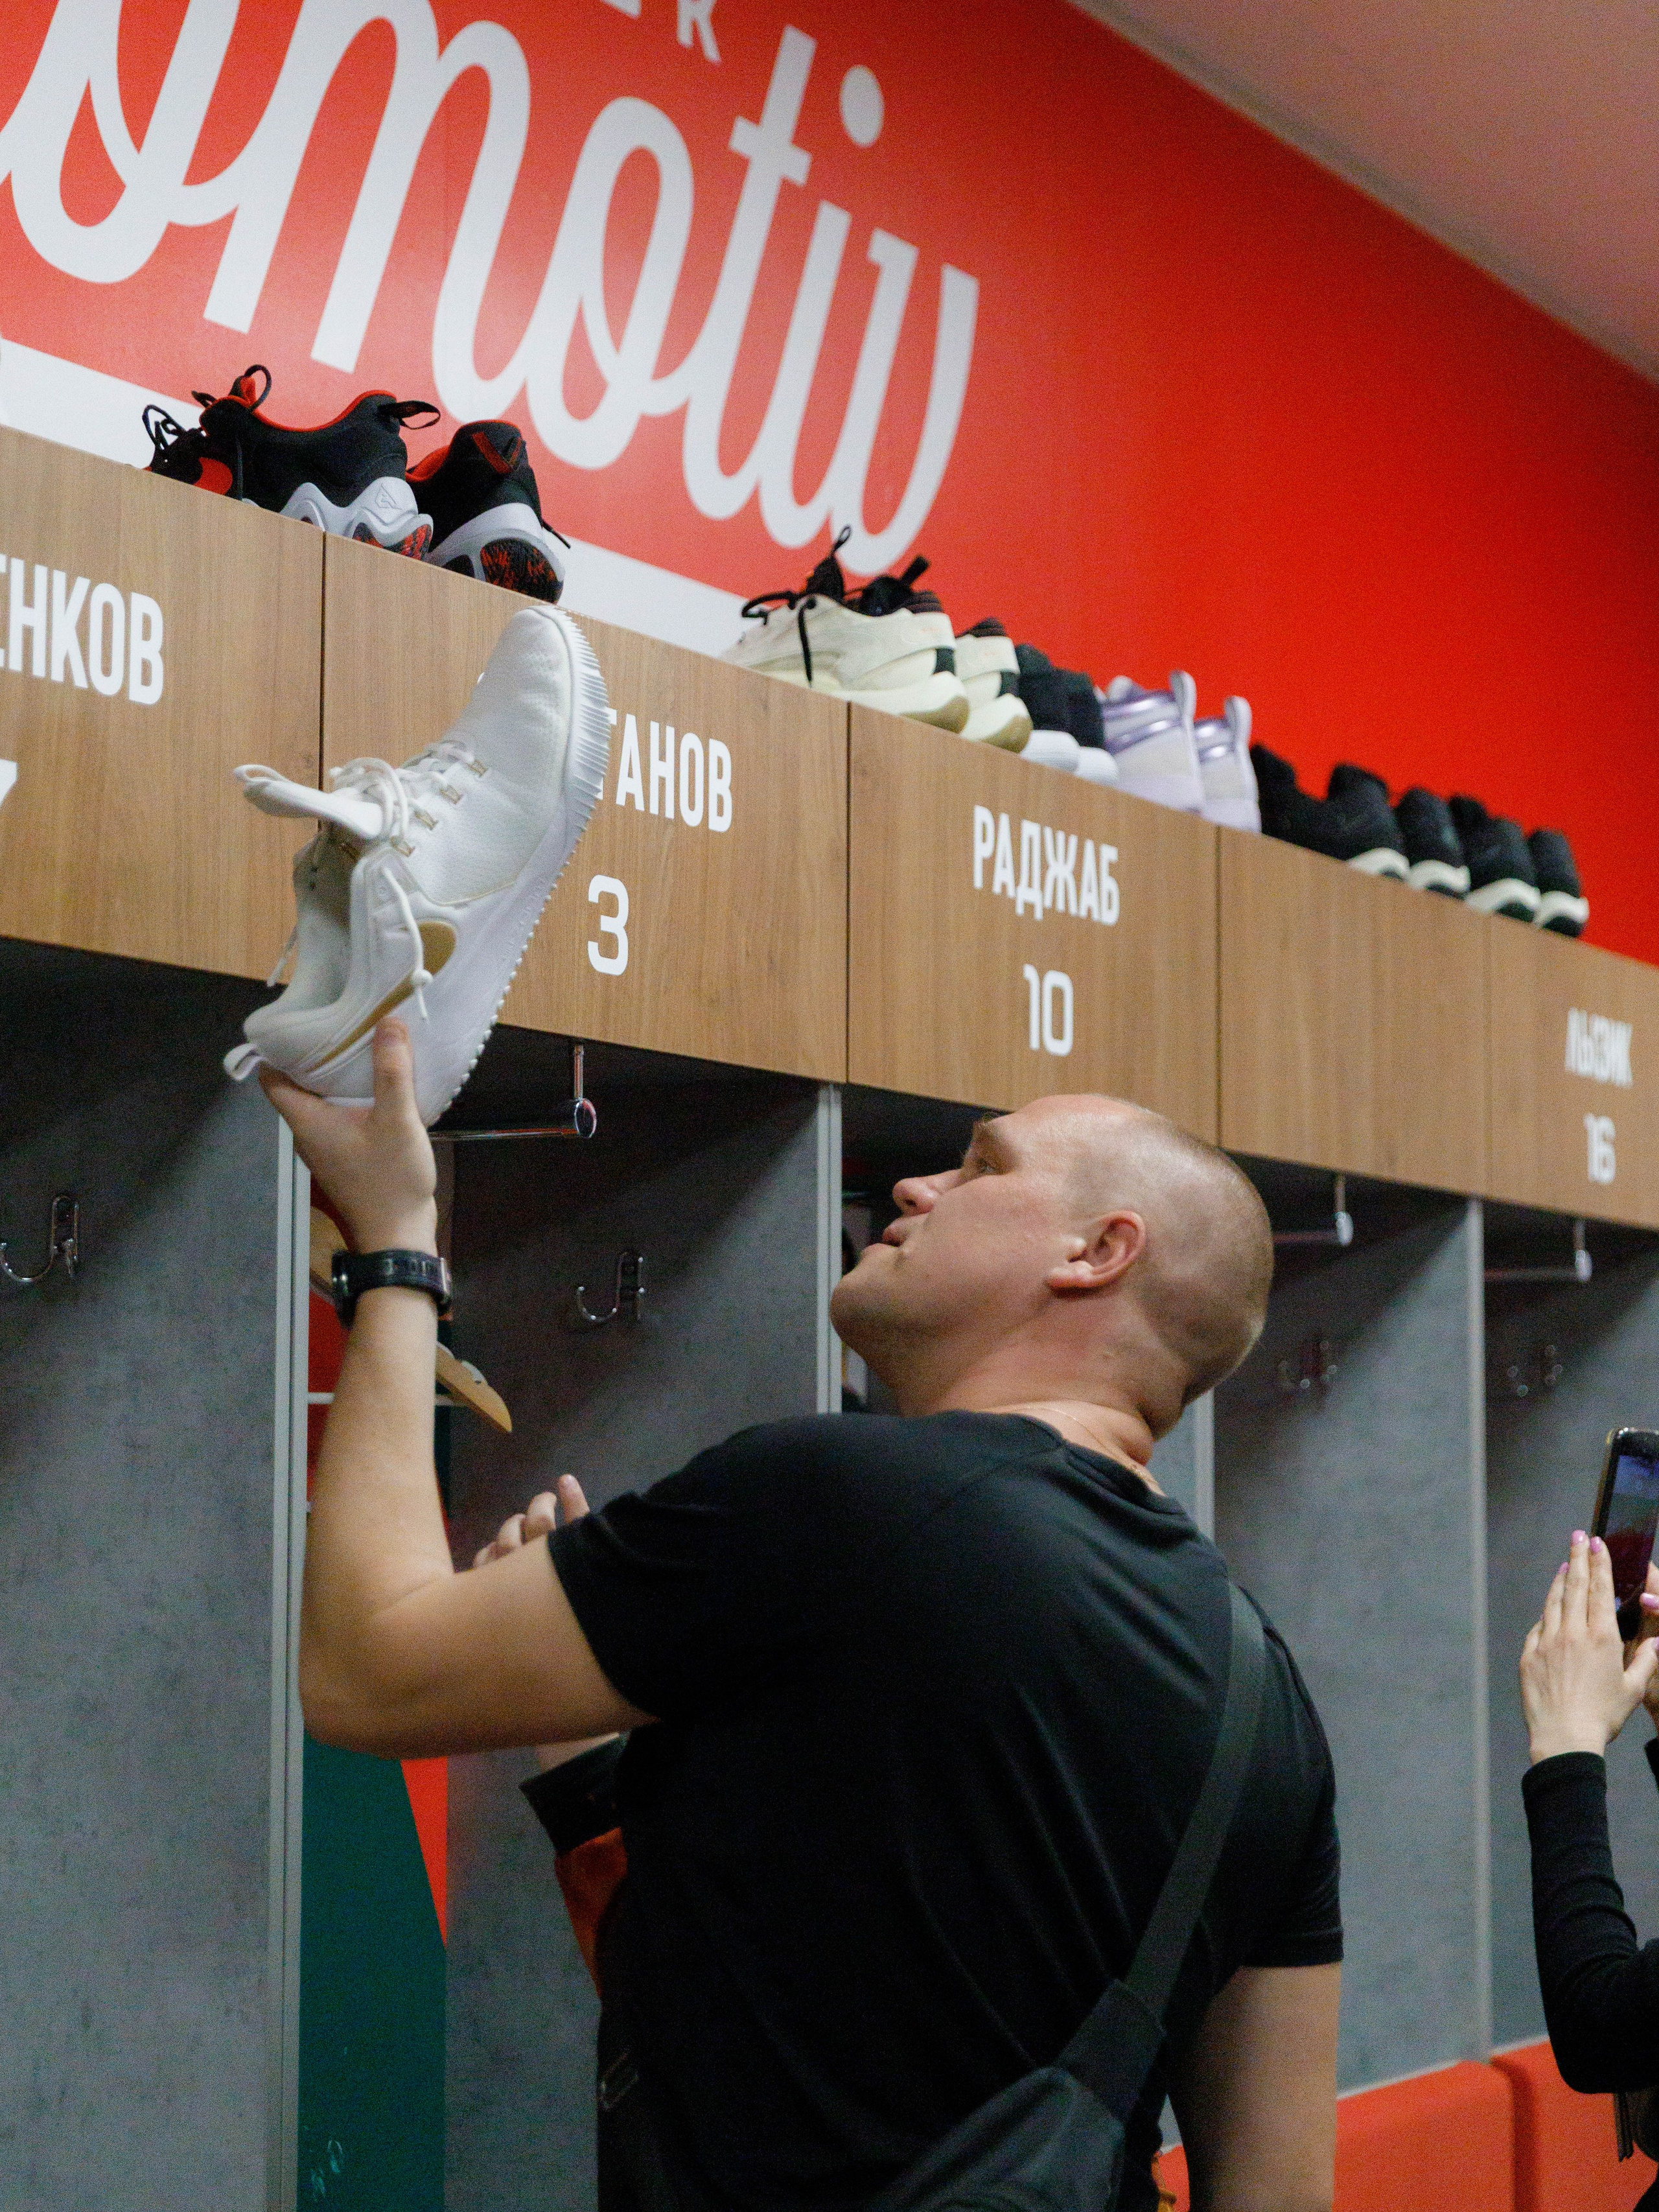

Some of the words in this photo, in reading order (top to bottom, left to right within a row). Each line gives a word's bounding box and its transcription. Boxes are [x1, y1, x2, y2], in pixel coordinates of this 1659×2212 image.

[973, 805, 1120, 926] РАДЖАБ
[587, 874, 629, 976] 3
[1023, 964, 1074, 1056] 10
[1583, 1113, 1617, 1185] 16
